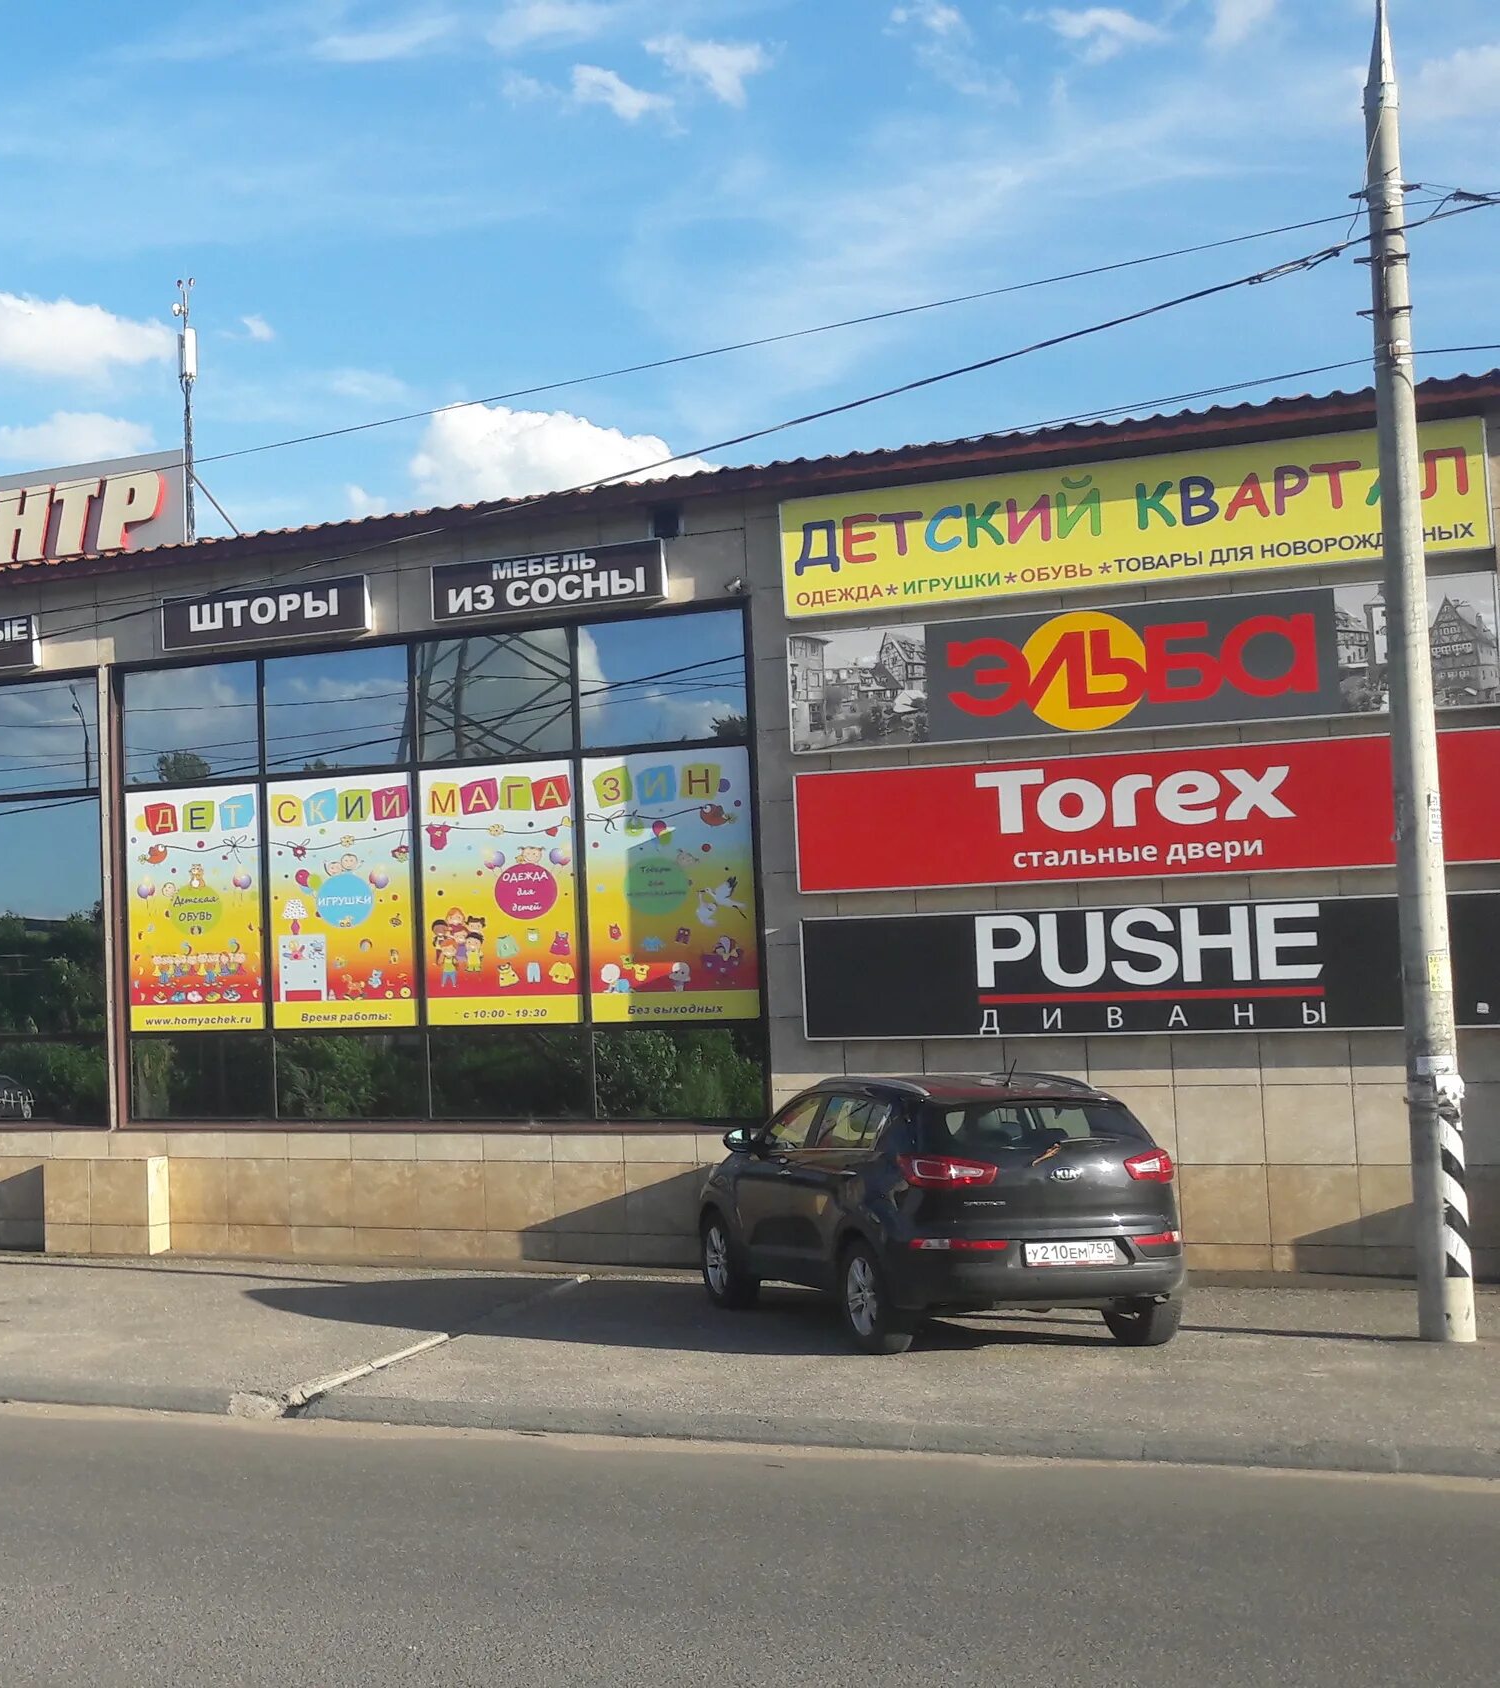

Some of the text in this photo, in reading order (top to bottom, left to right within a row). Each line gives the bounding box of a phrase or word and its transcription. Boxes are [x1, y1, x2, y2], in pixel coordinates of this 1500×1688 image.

[794, 446, 1469, 577] ДЕТСКИЙ КВАРТЛ
[491, 552, 597, 582] МЕБЕЛЬ
[796, 522, 1475, 607] ОДЕЖДА ИГРУШКИ ОБУВЬ ТОВАРЫ ДЛЯ НОВОРОЖДНЫХ
[446, 566, 646, 616] ИЗ СОСНЫ
[188, 588, 339, 633] ШТОРЫ
[974, 765, 1298, 835] Torex
[1012, 836, 1264, 869] стальные двери
[502, 871, 549, 883] ОДЕЖДА
[516, 887, 535, 897] для
[172, 895, 220, 906] Детская
[318, 894, 372, 907] ИГРУШКИ
[512, 902, 542, 912] детей
[178, 911, 213, 923] ОБУВЬ
[974, 902, 1324, 989] PUSHE
[473, 1009, 506, 1019] 10:00
[515, 1008, 548, 1018] 19:30
[627, 1003, 724, 1017] Без выходных
[145, 1015, 252, 1027] www.homyachek.ru
[300, 1011, 393, 1024] Время работы:
[979, 1000, 1328, 1036] ДИВАНЫ
[1056, 1168, 1082, 1179] KIA
[1089, 1243, 1111, 1254] 750
